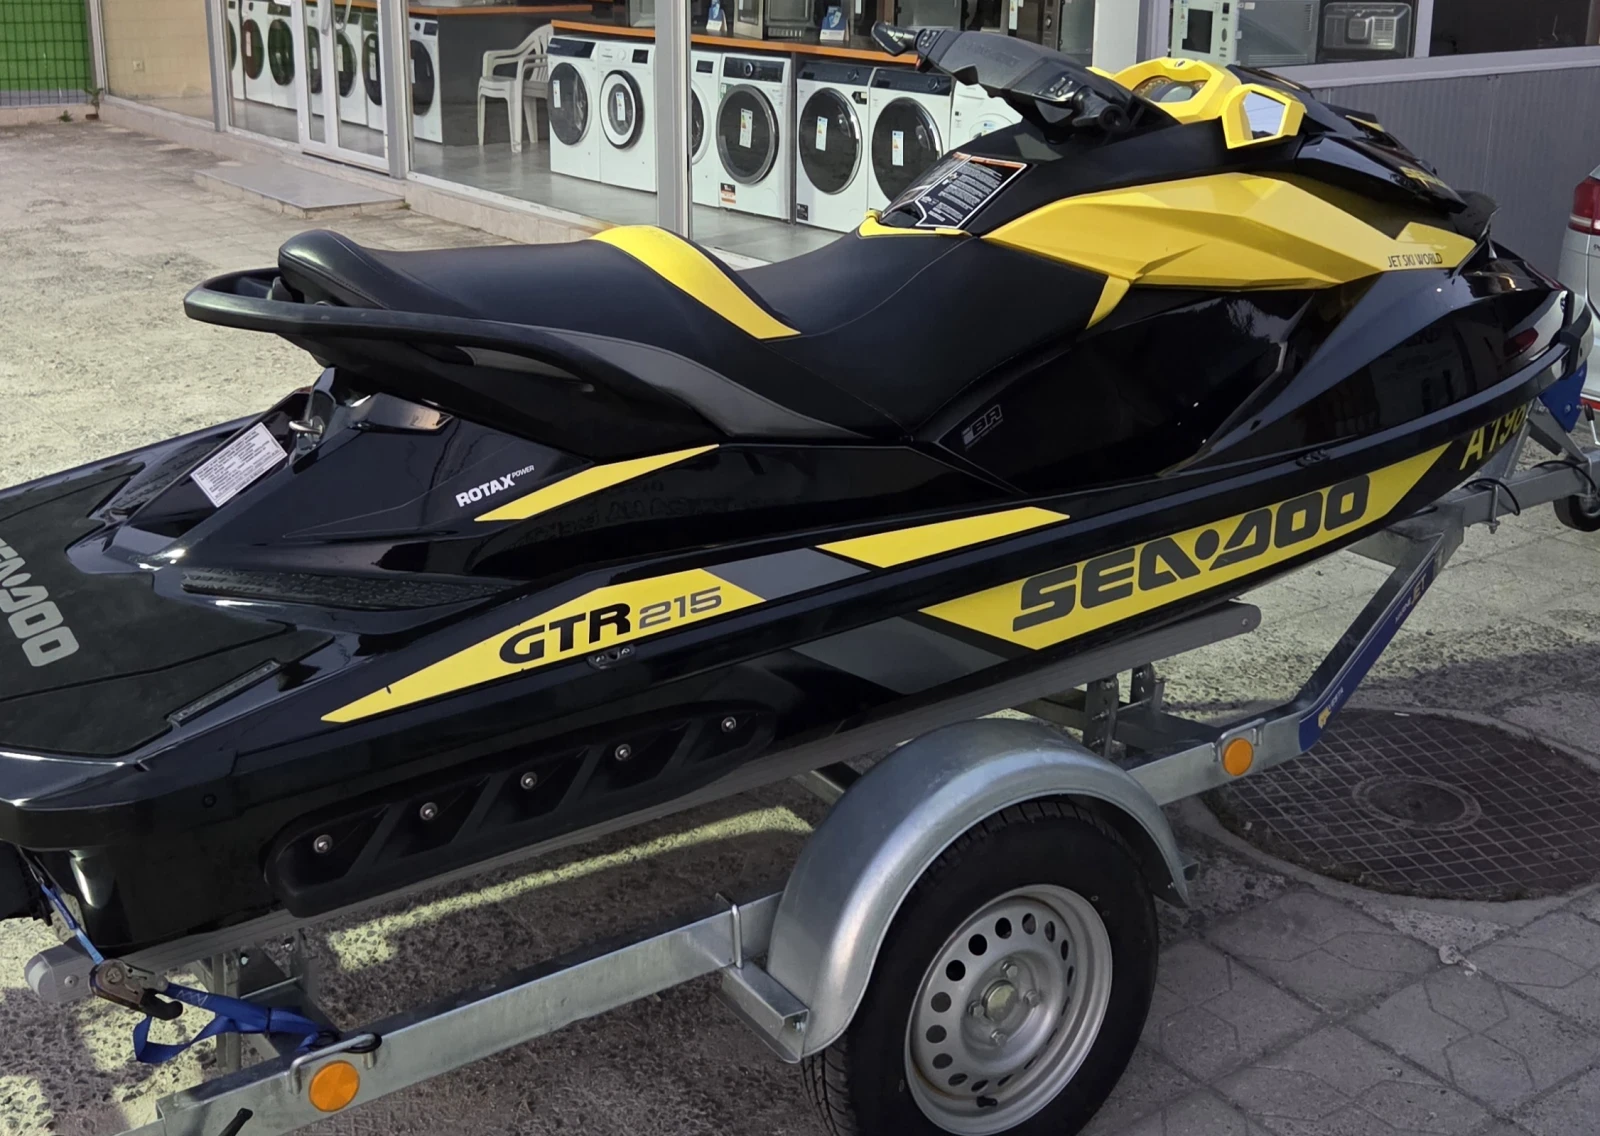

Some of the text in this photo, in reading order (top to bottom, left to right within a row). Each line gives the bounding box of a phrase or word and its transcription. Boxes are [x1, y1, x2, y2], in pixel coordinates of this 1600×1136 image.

[1388, 252, 1443, 268] JET SKI WORLD
[455, 464, 535, 508] ROTAX POWER
[499, 586, 722, 665] GTR 215
